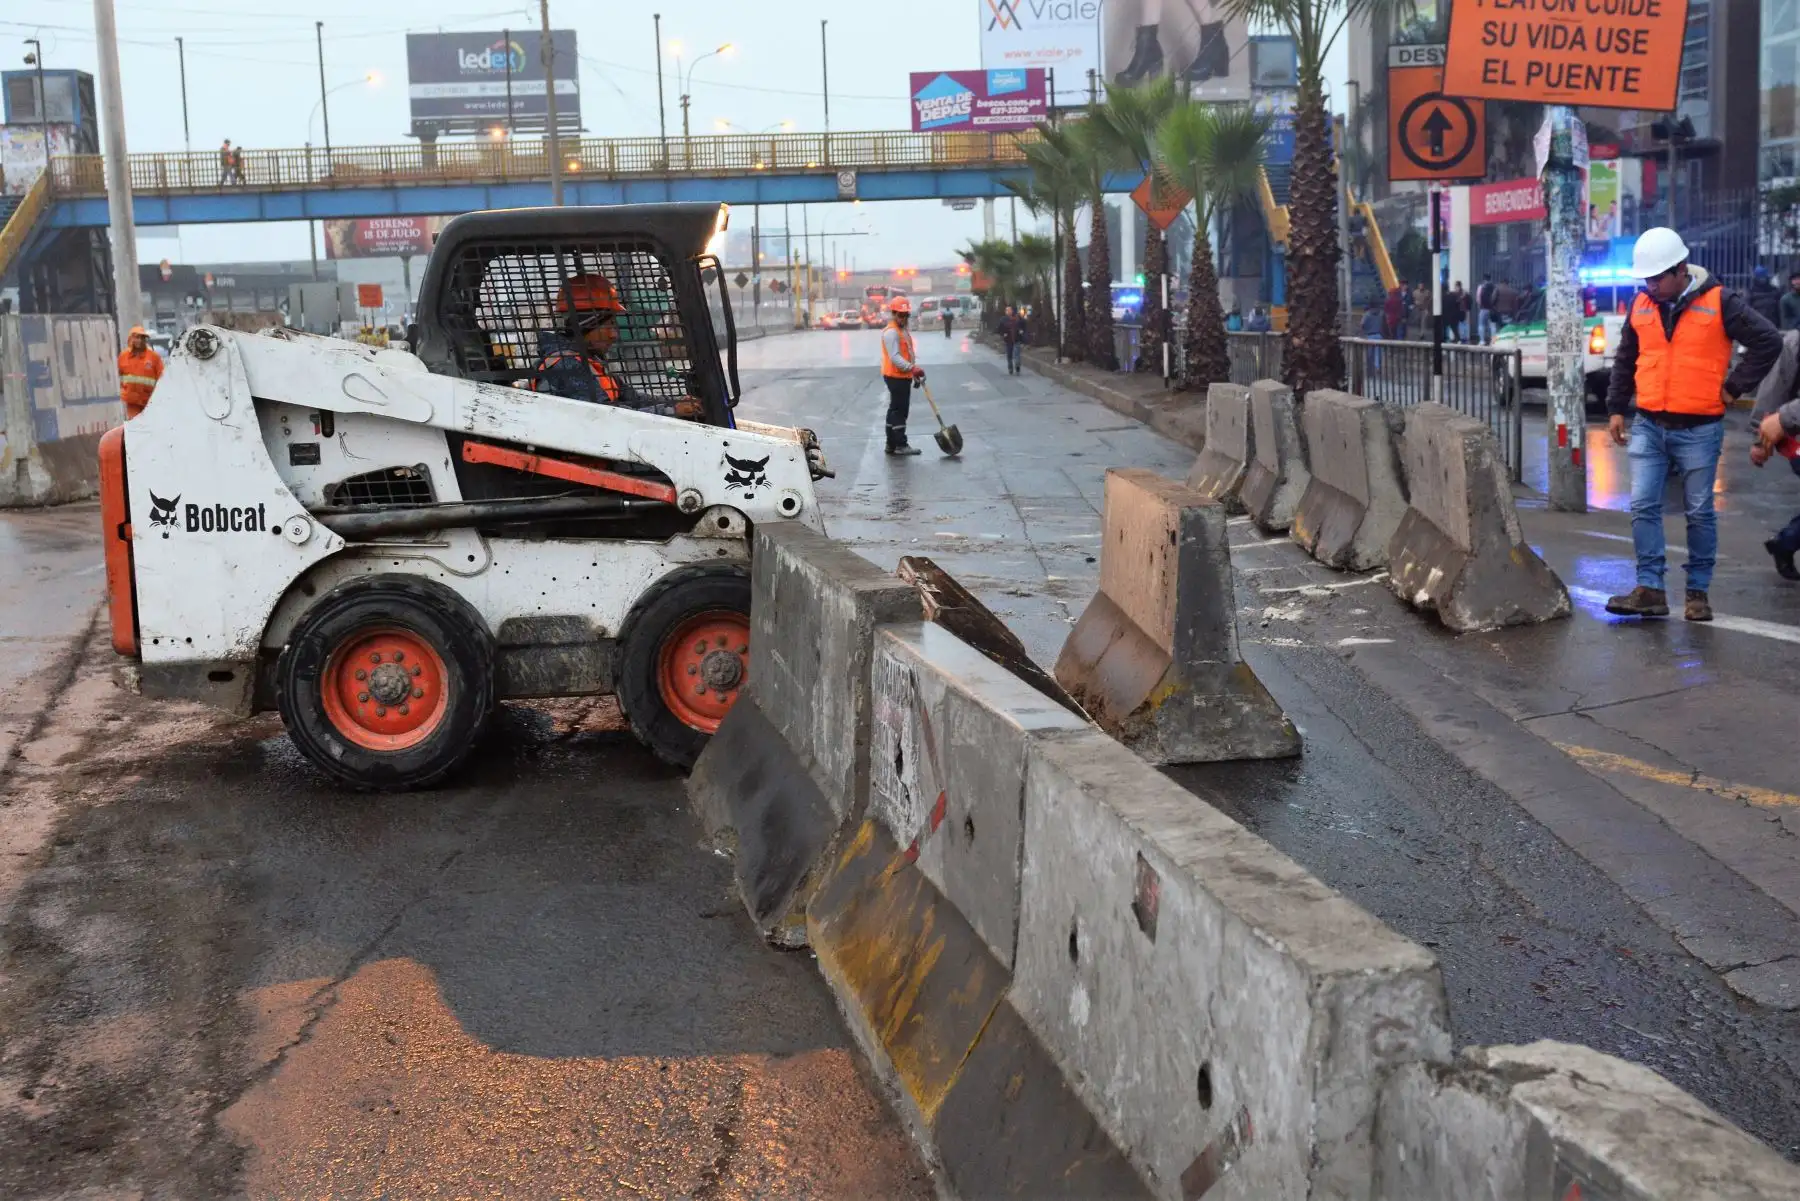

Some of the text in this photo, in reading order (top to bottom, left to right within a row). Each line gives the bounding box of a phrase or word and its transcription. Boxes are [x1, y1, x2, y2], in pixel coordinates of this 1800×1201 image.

[1029, 0, 1097, 20] Viale
[1481, 20, 1650, 55] SU VIDA USE
[1482, 58, 1641, 93] EL PUENTE
[915, 91, 973, 111] VENTA DE
[920, 102, 972, 122] DEPAS
[370, 218, 414, 229] ESTRENO
[364, 228, 421, 240] 18 DE JULIO
[185, 502, 266, 532] Bobcat
